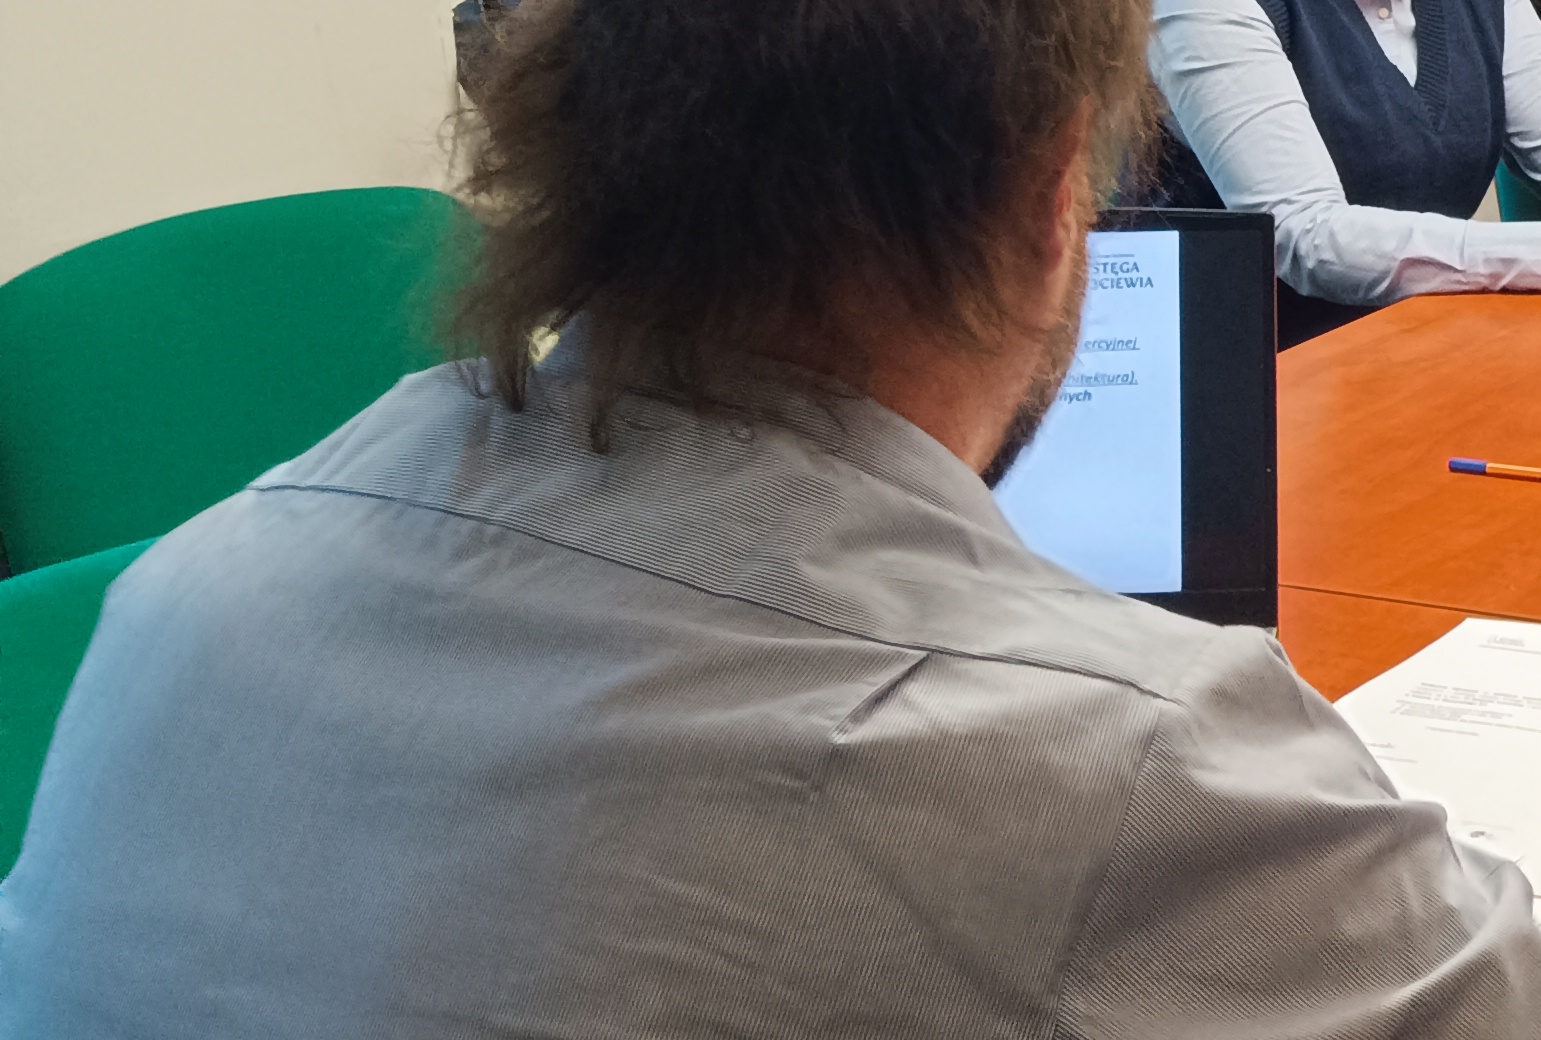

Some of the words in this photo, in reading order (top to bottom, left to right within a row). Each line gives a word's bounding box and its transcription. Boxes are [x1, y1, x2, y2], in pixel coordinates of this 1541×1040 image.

[1092, 262, 1140, 276] STĘGA
[1089, 277, 1154, 289] OCIEWIA
[1084, 338, 1140, 351] ercyjnej
[1059, 391, 1092, 404] nych
